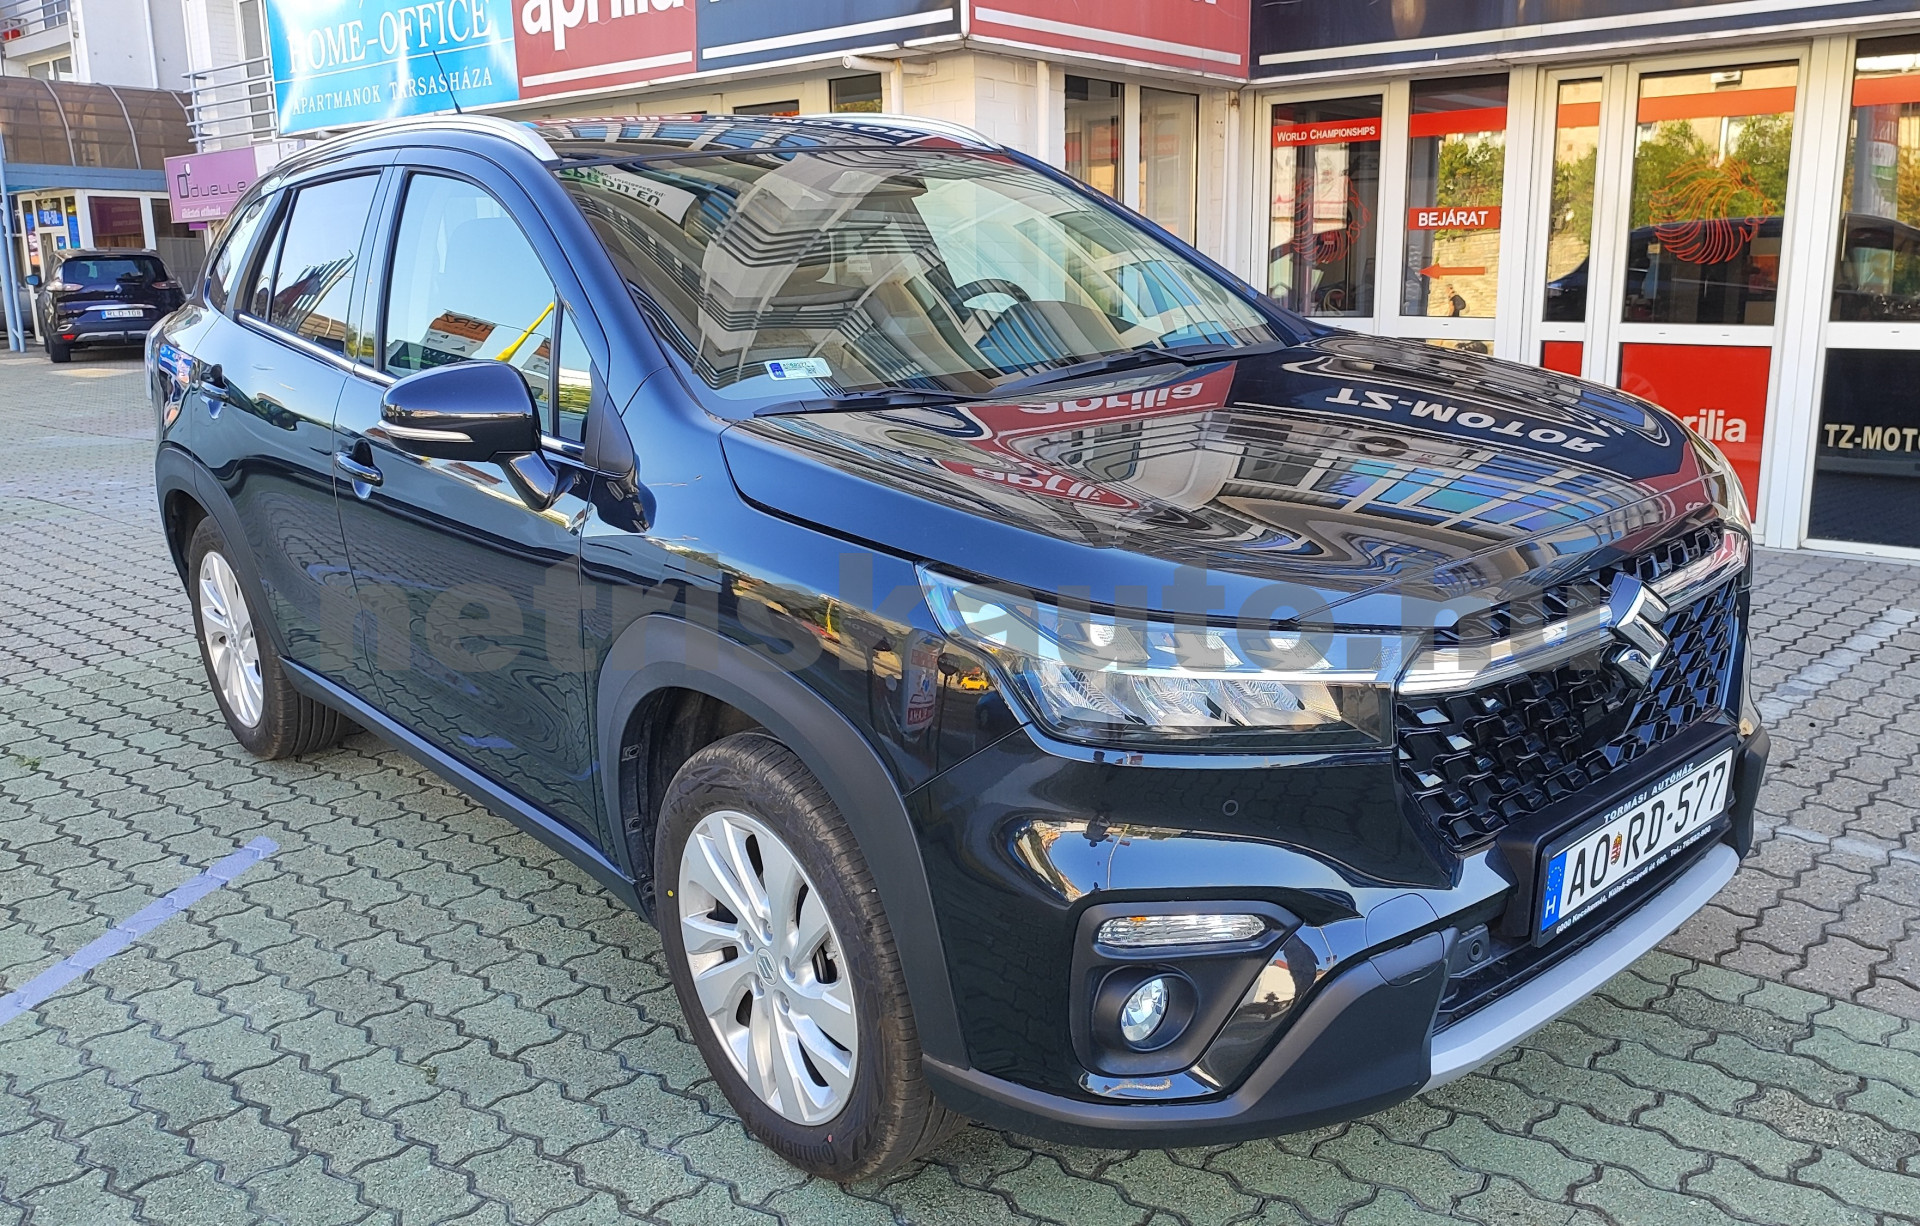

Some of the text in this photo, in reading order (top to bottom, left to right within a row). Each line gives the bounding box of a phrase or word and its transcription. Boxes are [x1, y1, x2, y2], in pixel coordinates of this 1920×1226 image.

[287, 0, 492, 74] HOME-OFFICE
[292, 84, 381, 115] APARTMANOK
[1418, 206, 1489, 227] BEJÁRAT
[1824, 423, 1920, 453] TZ-MOT
[1604, 762, 1694, 823] TORMÁSI AUTÓHÁZ
[1567, 759, 1726, 906] AO RD-577
[1544, 895, 1557, 919] H
